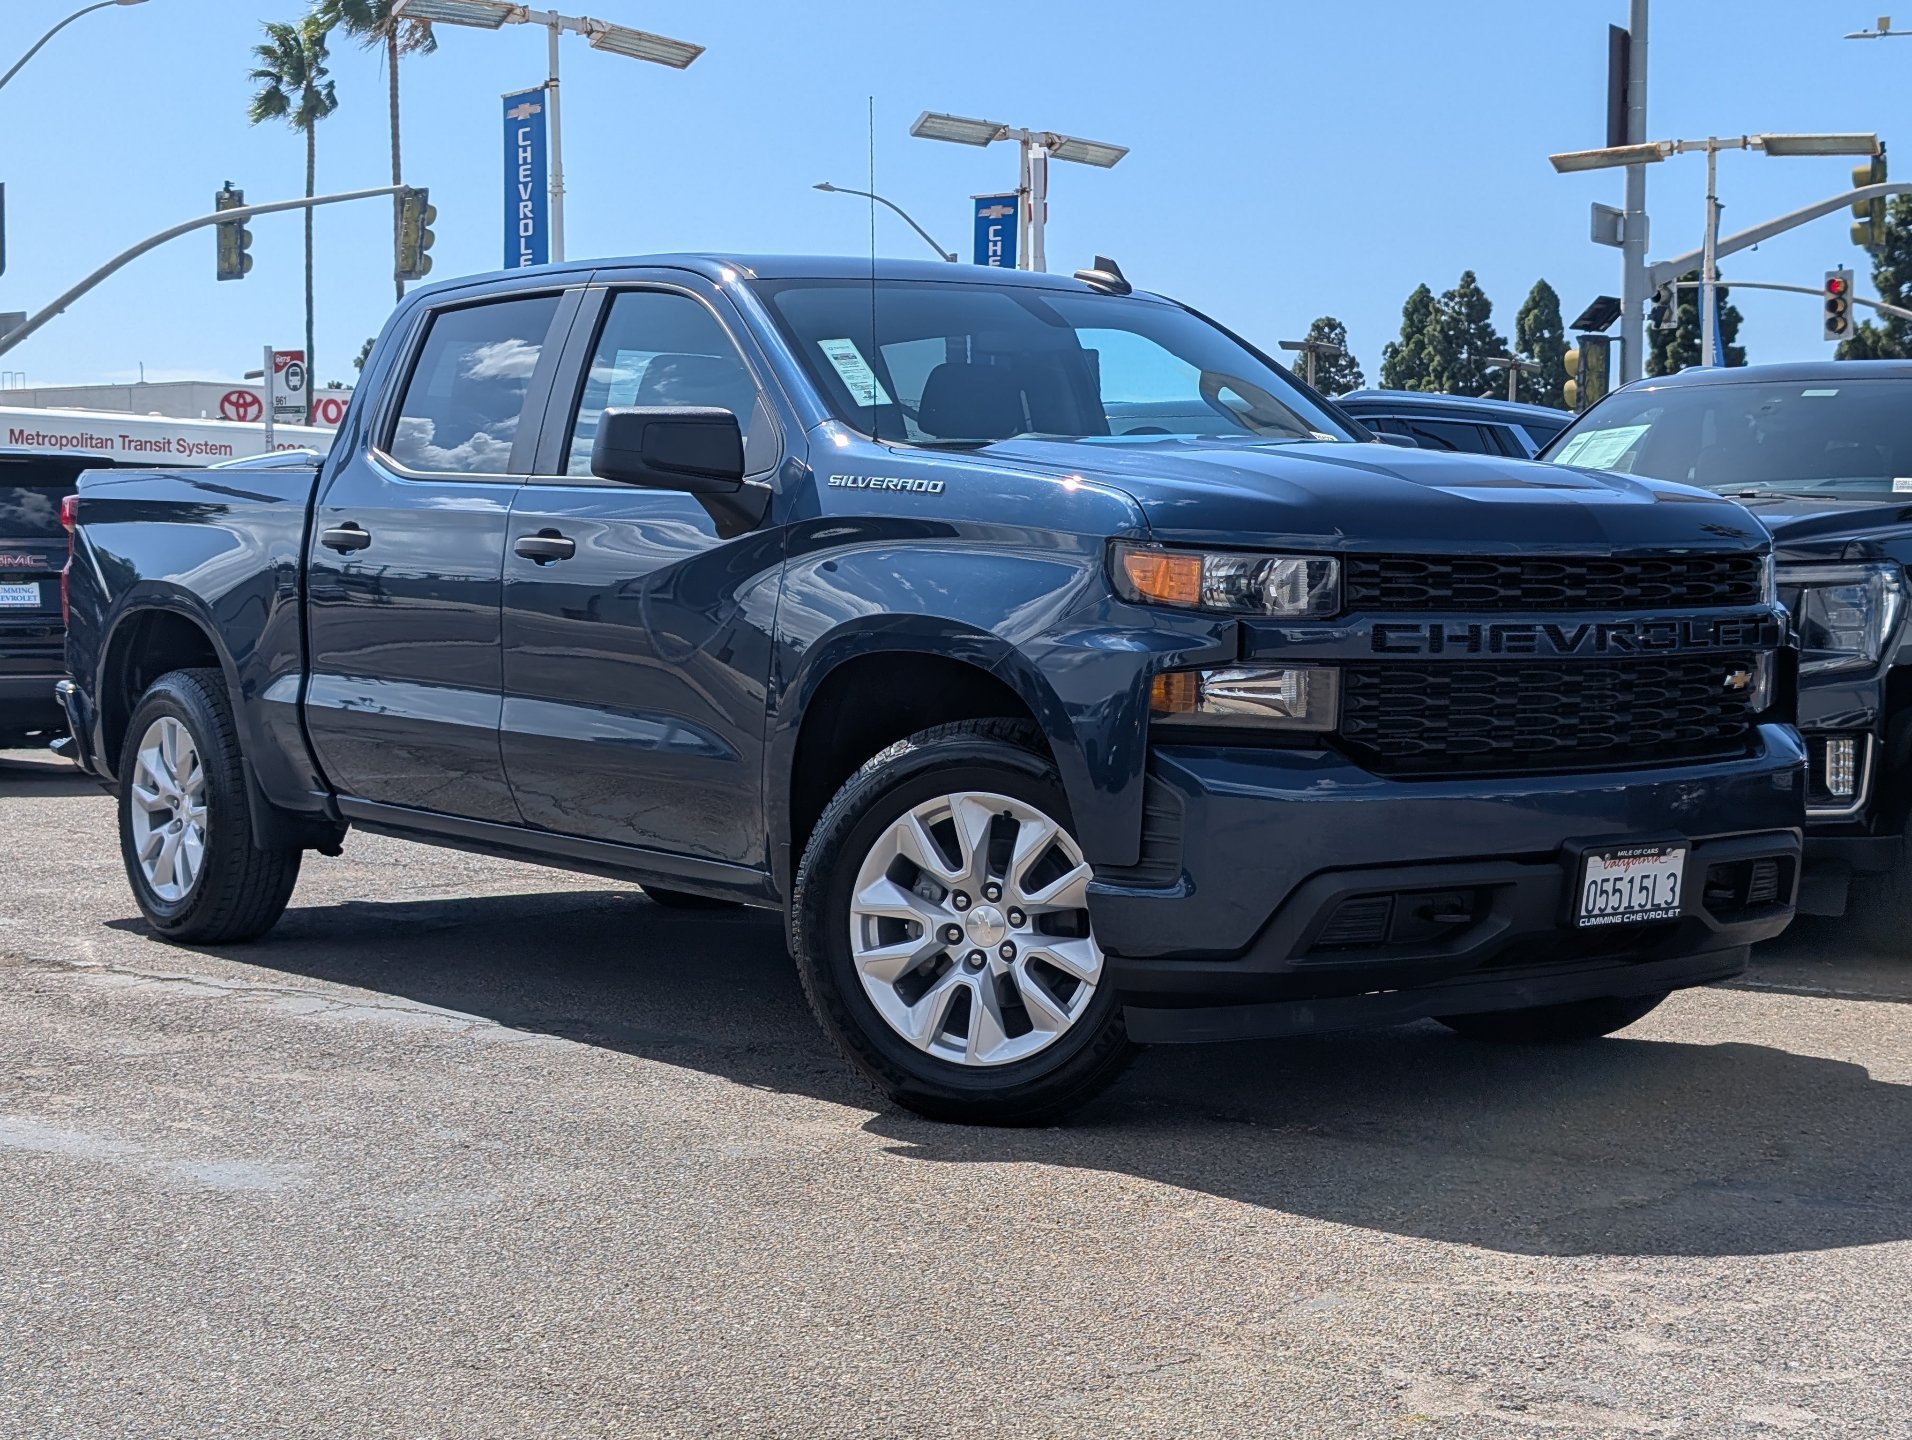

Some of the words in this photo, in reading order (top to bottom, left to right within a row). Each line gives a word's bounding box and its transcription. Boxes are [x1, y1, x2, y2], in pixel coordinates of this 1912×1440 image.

[275, 396, 287, 405] 961
[9, 428, 114, 450] Metropolitan
[119, 434, 172, 453] Transit
[176, 437, 233, 457] System
[827, 474, 945, 494] SILVERADO
[0, 554, 48, 567] MC
[1371, 620, 1770, 654] CHEVROLET
[1617, 849, 1633, 857] MILE
[1643, 847, 1660, 855] CARS
[1584, 872, 1678, 914] 05515L3
[1579, 914, 1623, 927] CUMMING
[1623, 908, 1681, 922] CHEVROLET
